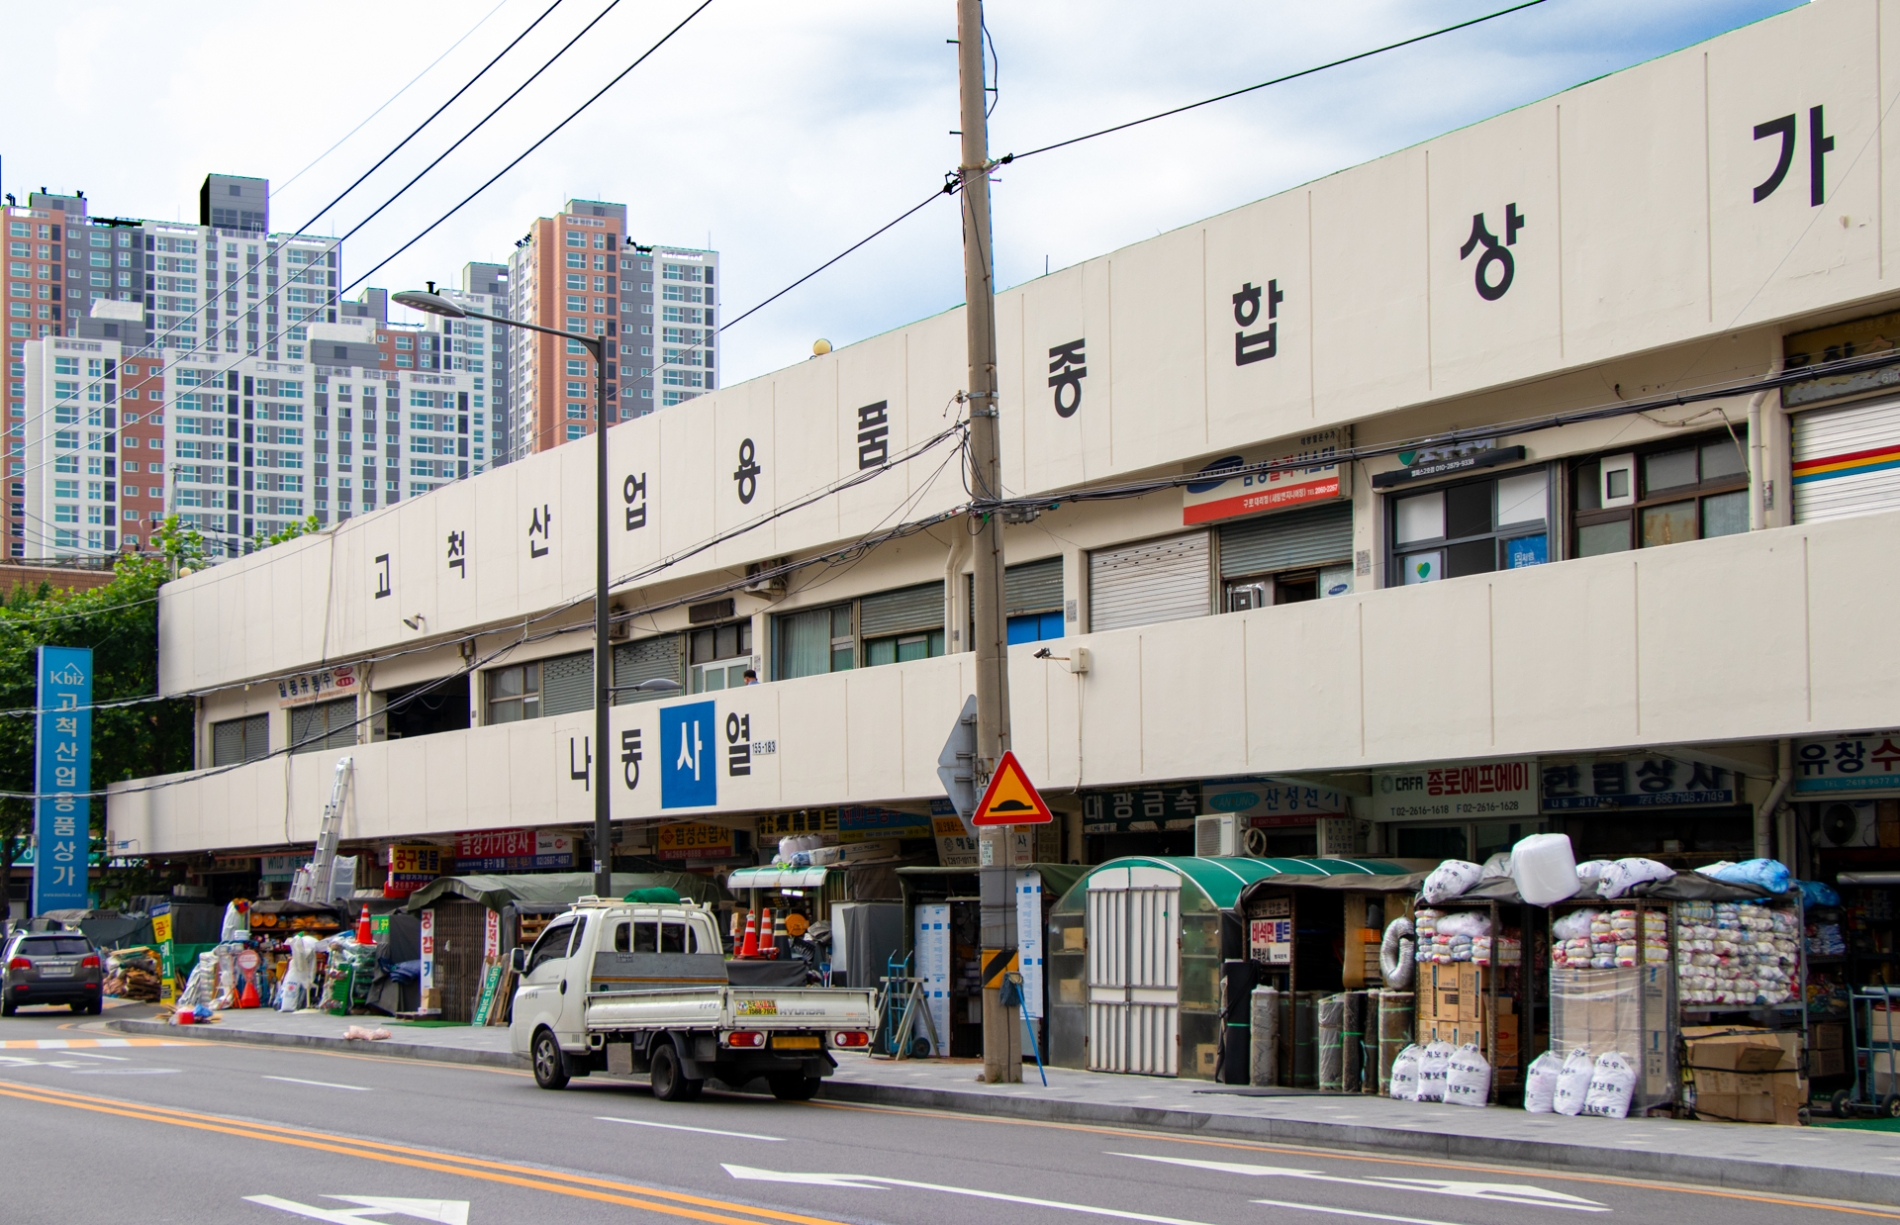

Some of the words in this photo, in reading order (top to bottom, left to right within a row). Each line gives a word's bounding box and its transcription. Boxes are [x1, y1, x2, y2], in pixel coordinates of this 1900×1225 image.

[50, 669, 84, 686] Kbiz
[752, 740, 777, 754] 155-183
[53, 693, 78, 886] 고척산업용품상가
[1428, 763, 1529, 796] 종로에프에이
[1543, 760, 1727, 797] 한림상사
[1084, 788, 1197, 820] 대광금속
[461, 830, 529, 856] 금강기기상사
[675, 826, 729, 846] 협성산업사
[1252, 922, 1274, 944] 비석면
